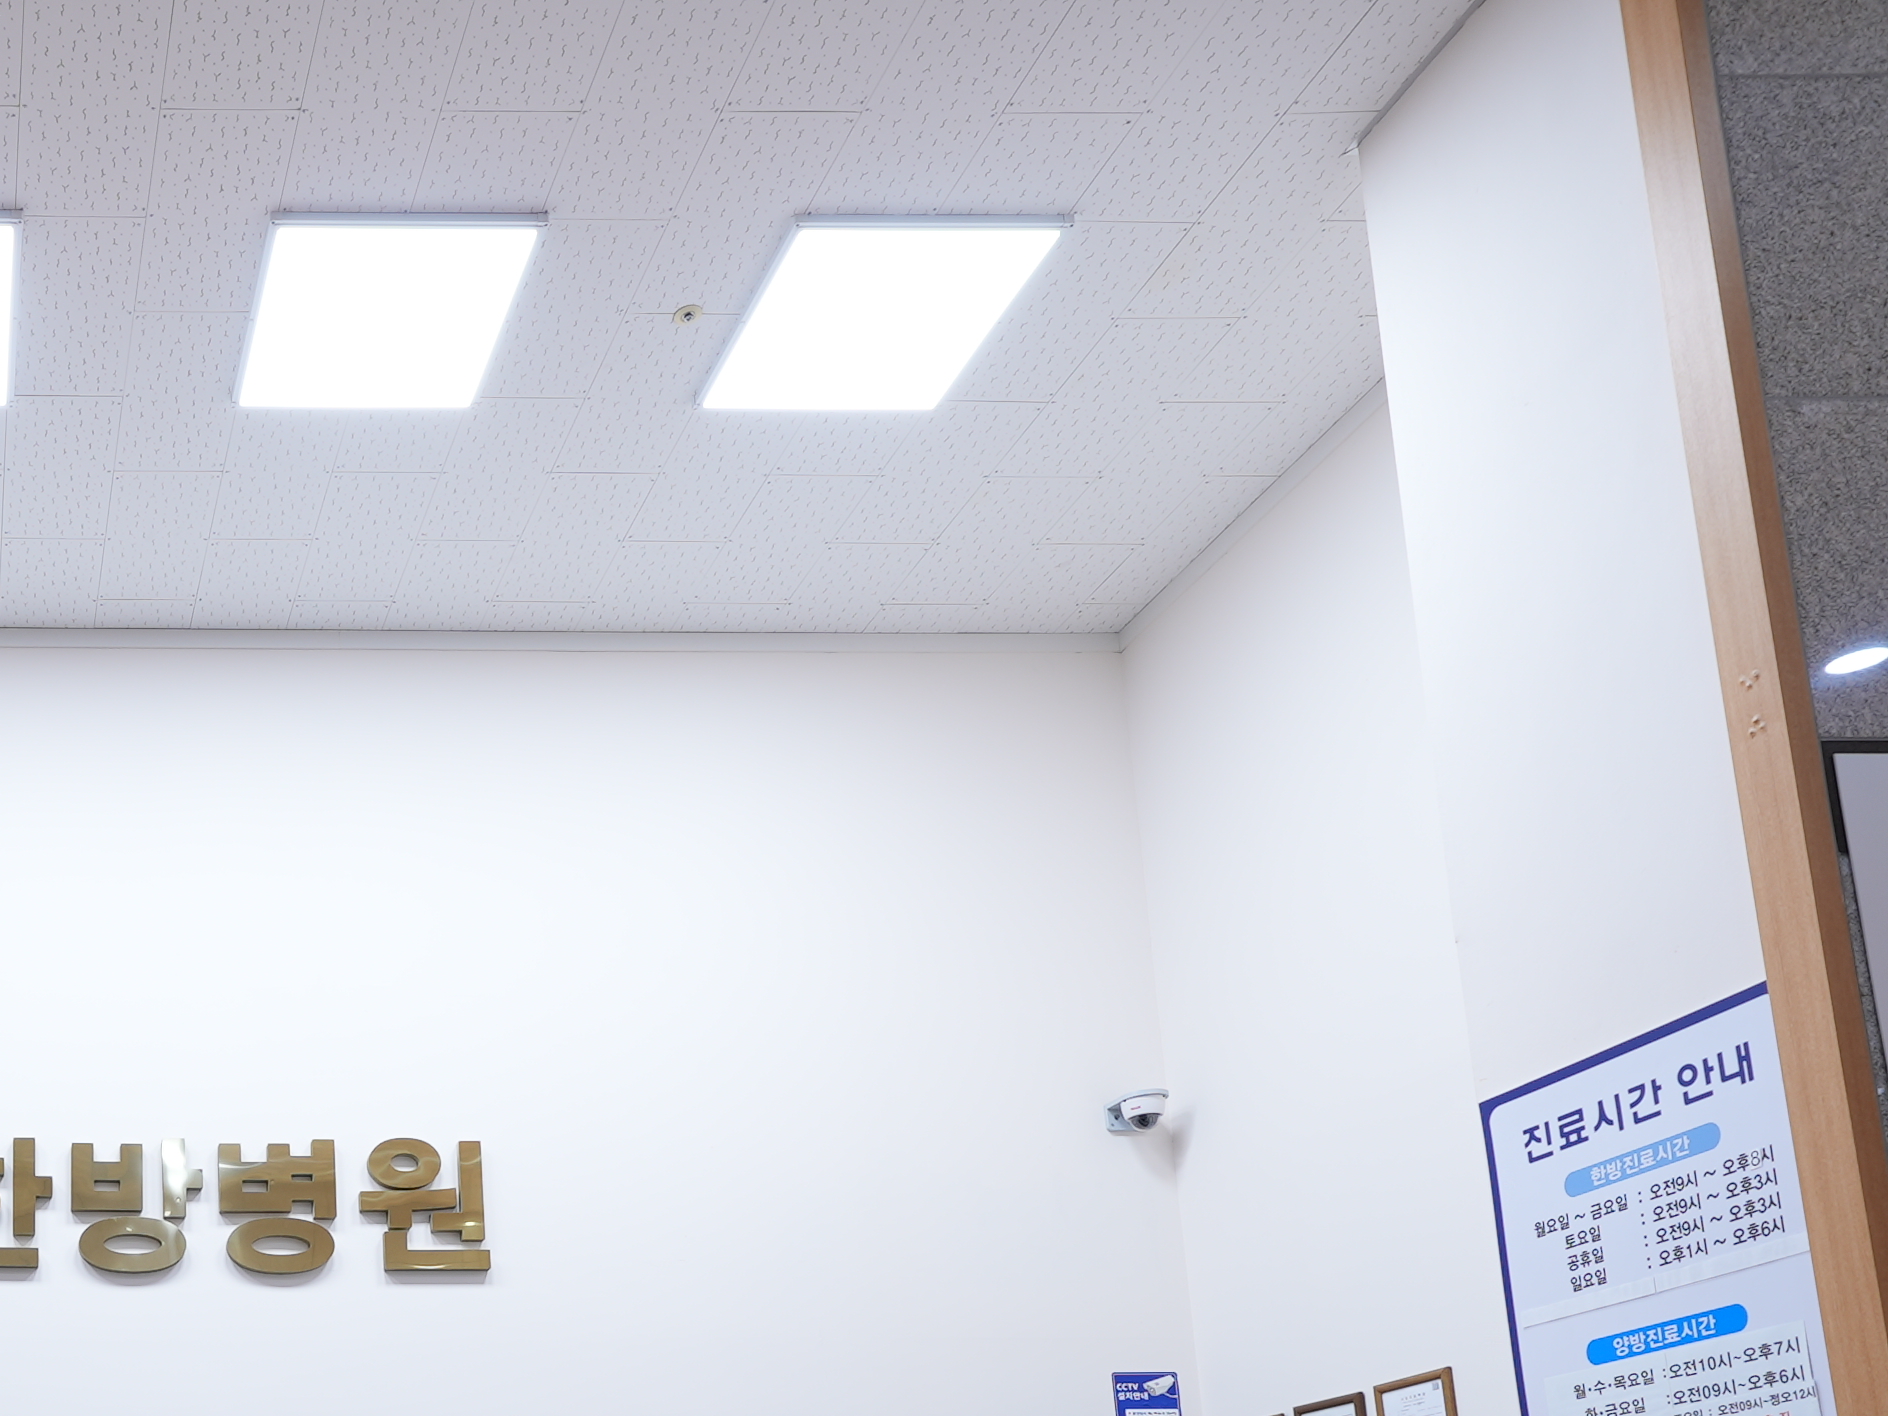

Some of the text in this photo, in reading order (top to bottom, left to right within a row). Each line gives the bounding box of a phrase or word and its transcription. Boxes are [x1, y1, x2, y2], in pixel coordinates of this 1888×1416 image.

[1522, 1041, 1755, 1163] 진료시간 안내
[1534, 1144, 1774, 1238] 월요일 금요일 오전9시 오후8시
[1590, 1135, 1691, 1186] 한방진료시간
[1565, 1168, 1778, 1250] 토요일 오전9시 오후3시
[1567, 1191, 1782, 1272] 공휴일 오전9시 오후3시
[1570, 1215, 1785, 1292] 일요일 오후1시 오후6시
[1613, 1315, 1717, 1356] 양방진료시간
